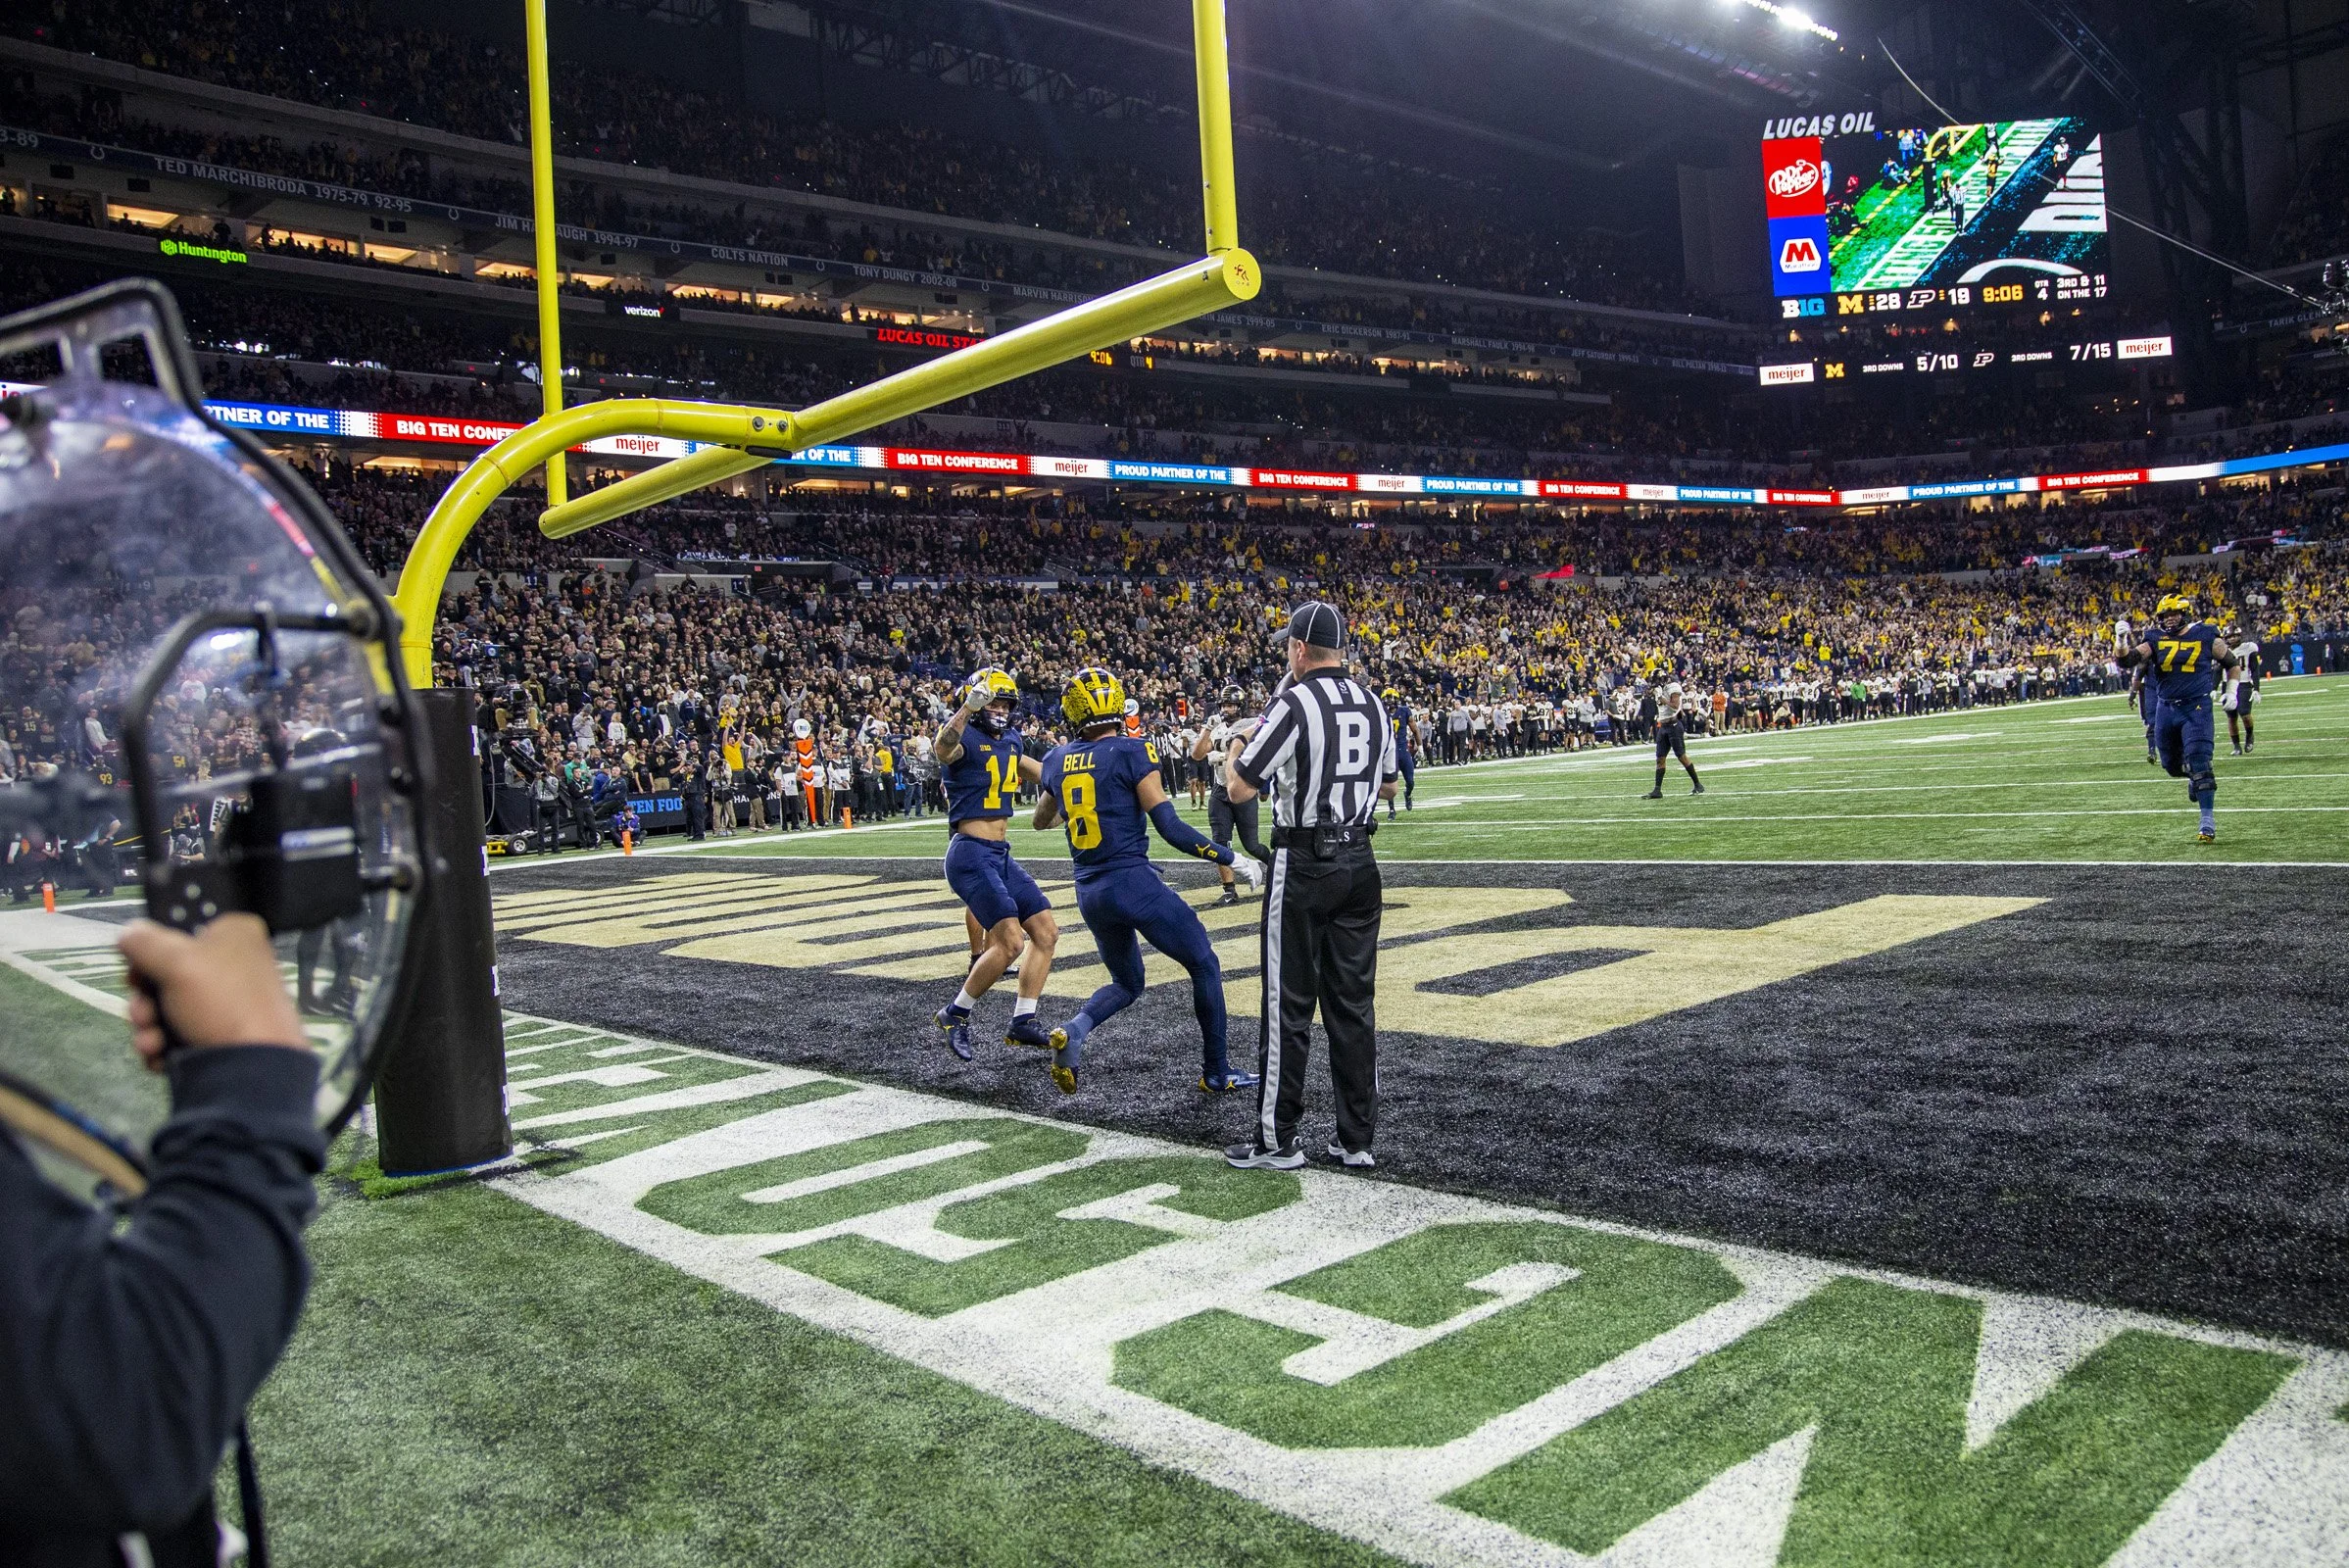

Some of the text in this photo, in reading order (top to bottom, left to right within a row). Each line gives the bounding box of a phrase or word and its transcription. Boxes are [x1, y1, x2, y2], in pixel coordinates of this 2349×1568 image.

[1763, 112, 1876, 140] LUCAS OIL
[155, 157, 187, 174] TED
[193, 165, 307, 196] MARCHIBRODA
[374, 196, 413, 213] 92-95
[495, 217, 638, 248] JIM HAAUGH 1994-97
[178, 241, 247, 264] Huntington
[711, 247, 788, 268] COLTS NATION
[853, 265, 957, 288] TONY DUNGY 2002-08
[2057, 277, 2078, 289] 3RD
[2093, 274, 2106, 285] 11
[1013, 286, 1049, 301] MARVIN
[1876, 293, 1901, 312] 28
[1948, 287, 1971, 306] 19
[1982, 284, 2024, 303] 9:06
[2037, 288, 2048, 301] 4
[2058, 286, 2107, 300] ON THE 17
[624, 305, 661, 318] verizon
[1217, 314, 1242, 325] JAMES
[1322, 323, 1340, 334] ERIC
[1342, 325, 1382, 338] DICKERSON
[2269, 316, 2295, 328] TARIK
[878, 328, 922, 345] LUCAS
[926, 333, 950, 348] OIL
[1090, 350, 1113, 366] 9:06
[1146, 356, 1153, 369] 4
[1768, 367, 1805, 381] meijer
[1878, 363, 1904, 372] DOWNS
[1916, 354, 1959, 372] 5/10
[2027, 352, 2052, 362] DOWNS
[2070, 343, 2112, 361] 7/15
[2126, 340, 2164, 355] meijer
[267, 410, 292, 426] OF
[294, 413, 329, 429] THE
[397, 420, 425, 436] BIG
[429, 422, 461, 438] TEN
[615, 435, 661, 454] meijer
[808, 447, 827, 462] OF
[829, 449, 852, 463] THE
[897, 452, 1018, 470] BIG TEN CONFERENCE
[1054, 460, 1089, 475] meijer
[1115, 465, 1226, 481] PROUD PARTNER OF THE
[1259, 472, 1348, 488] BIG TEN CONFERENCE
[1378, 477, 1405, 490] meijer
[1427, 479, 1518, 492] PROUD PARTNER OF THE
[2047, 472, 2139, 487] BIG TEN CONFERENCE
[1545, 484, 1620, 496] BIG TEN CONFERENCE
[1642, 487, 1664, 499] meijer
[1681, 489, 1751, 501] PROUD PARTNER OF THE
[1862, 490, 1889, 503] meijer
[1913, 481, 2015, 496] PROUD PARTNER OF THE
[2158, 640, 2202, 672] 77
[1144, 741, 1159, 763] 8
[1335, 711, 1370, 776] B
[1063, 752, 1097, 773] BELL
[983, 755, 1018, 809] 14
[1061, 772, 1102, 850] 8
